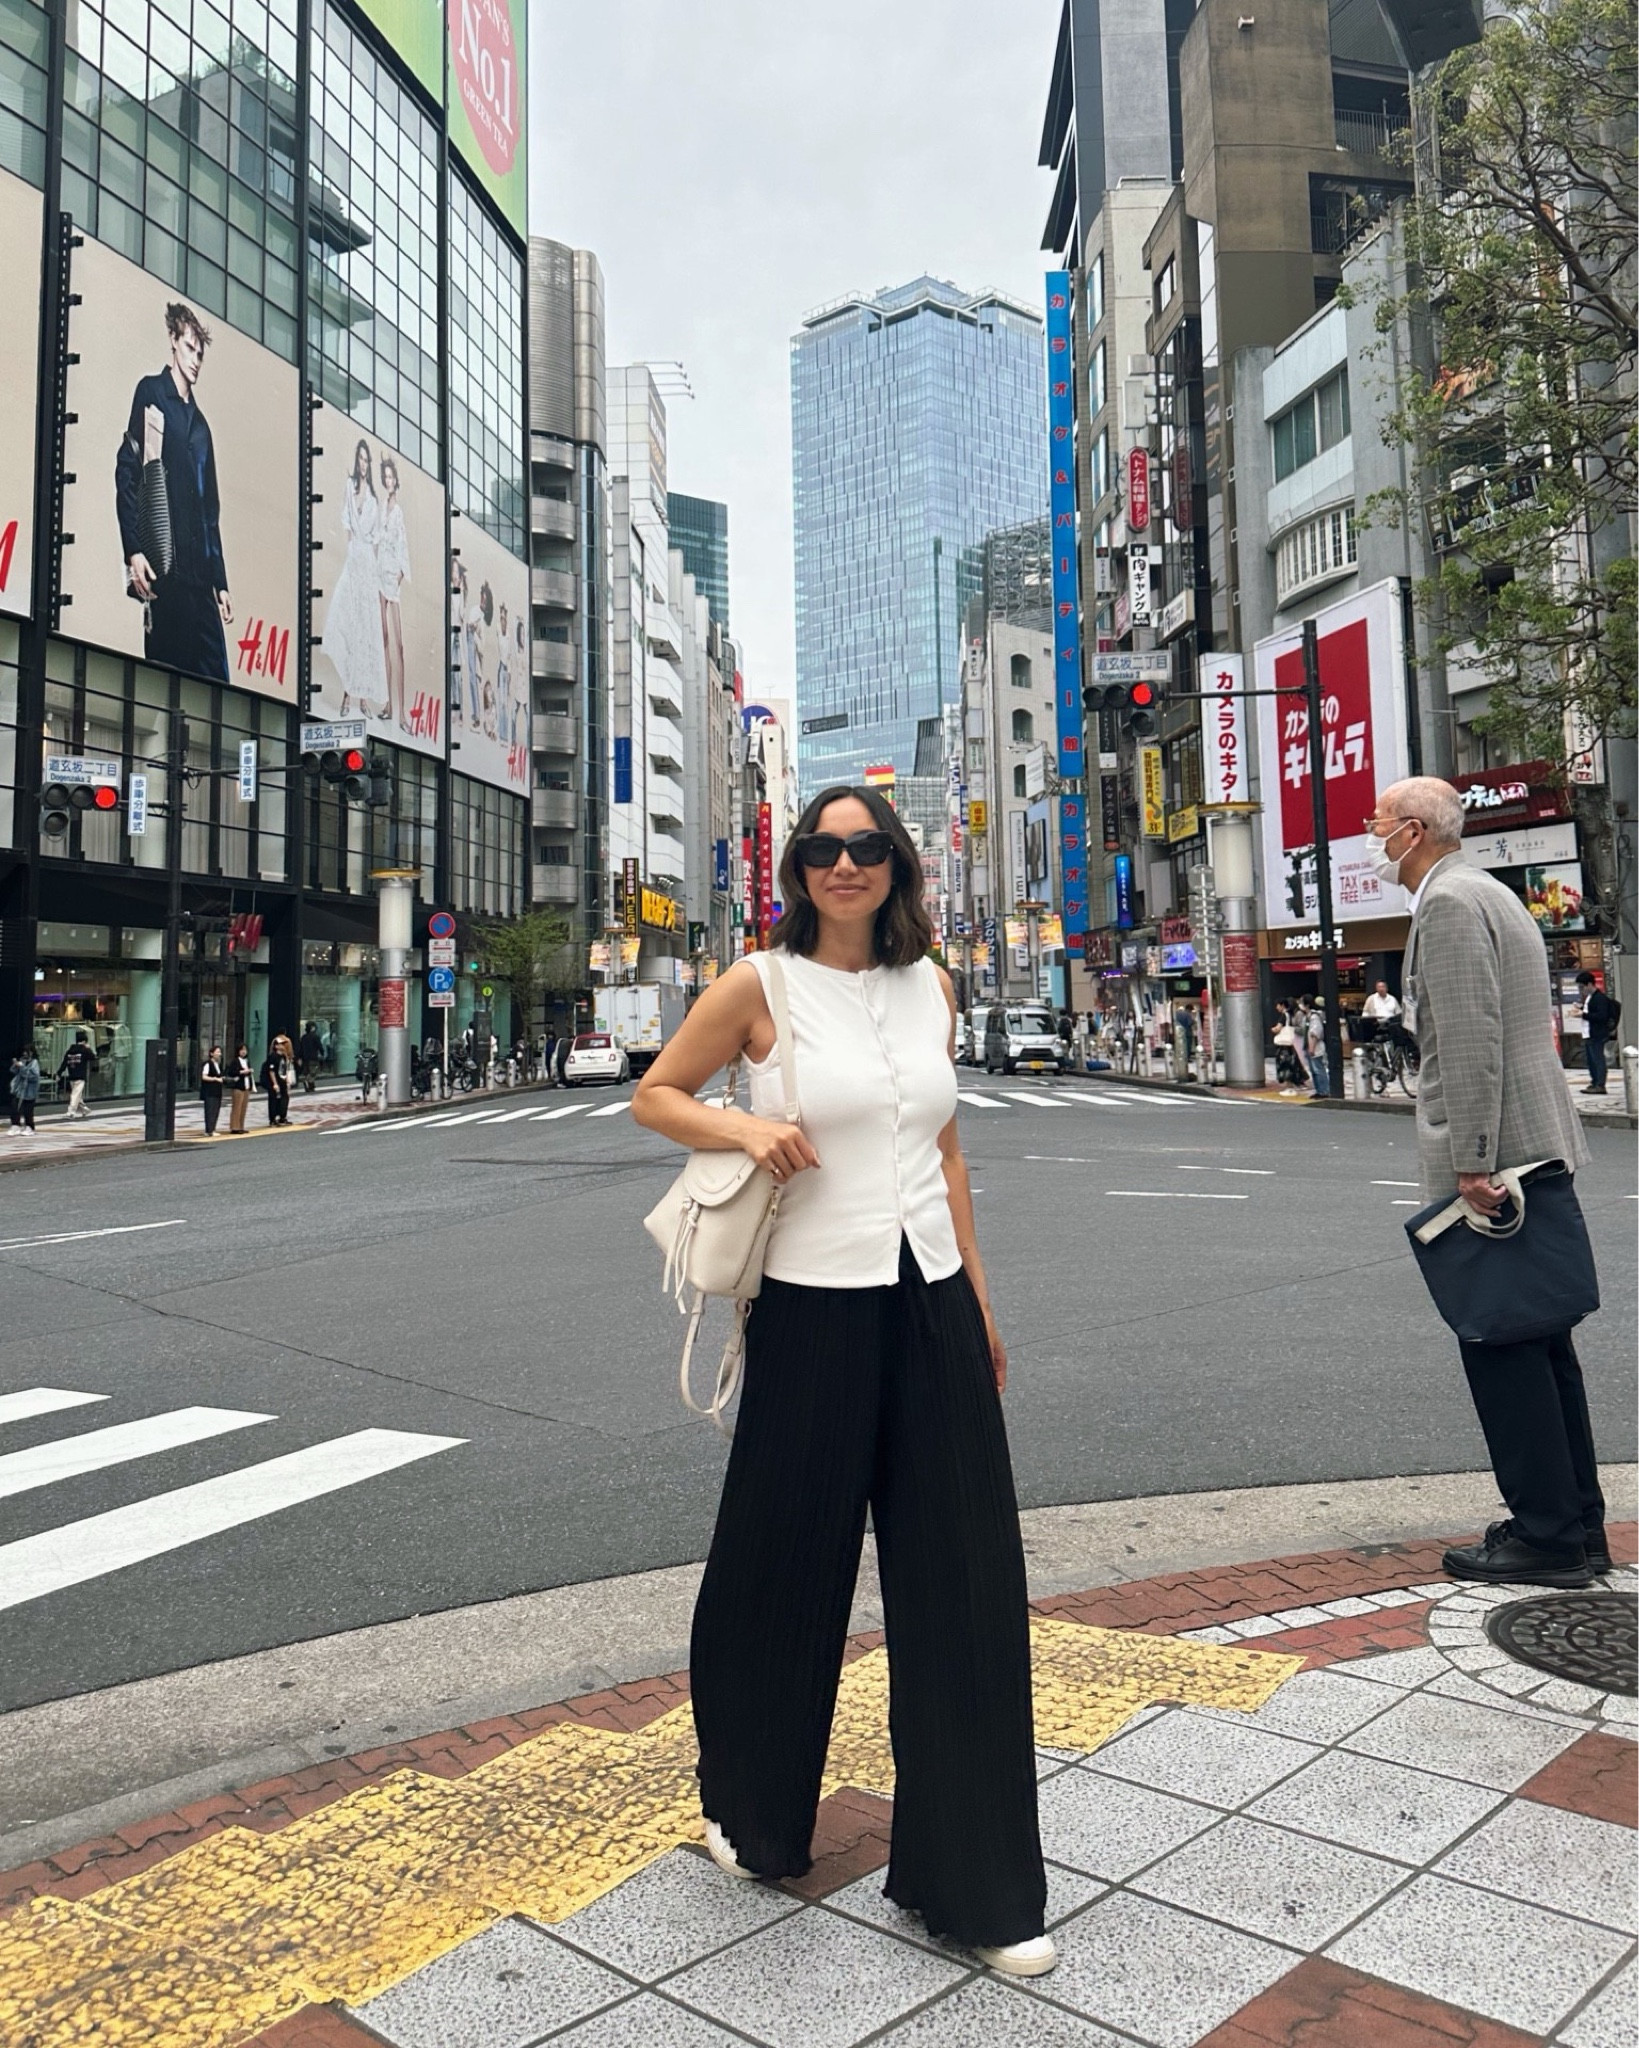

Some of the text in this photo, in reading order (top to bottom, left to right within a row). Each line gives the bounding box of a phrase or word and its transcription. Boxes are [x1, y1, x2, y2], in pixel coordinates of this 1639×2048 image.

[459, 0, 513, 135] No.1
[464, 78, 508, 158] GREEN TEA
[238, 616, 289, 685] H&M
[1096, 656, 1167, 672] 道玄坂二丁目
[1099, 672, 1134, 680] Dogenzaka
[410, 691, 440, 744] H&M
[303, 724, 363, 740] 道玄坂二丁目
[305, 741, 334, 749] Dogenzaka
[49, 758, 117, 777] 道玄坂二丁目
[242, 745, 253, 798] 歩車分離式
[507, 743, 527, 785] H&M
[50, 773, 92, 783] Dogenzaka 2
[133, 779, 144, 831] 歩車分離式
[1064, 802, 1083, 949] カラオケ館
[1340, 875, 1358, 891] TAX
[1362, 879, 1379, 894] 免税
[1340, 891, 1359, 904] FREE
[1285, 929, 1343, 950] カメラのキラ
[434, 973, 445, 989] P
